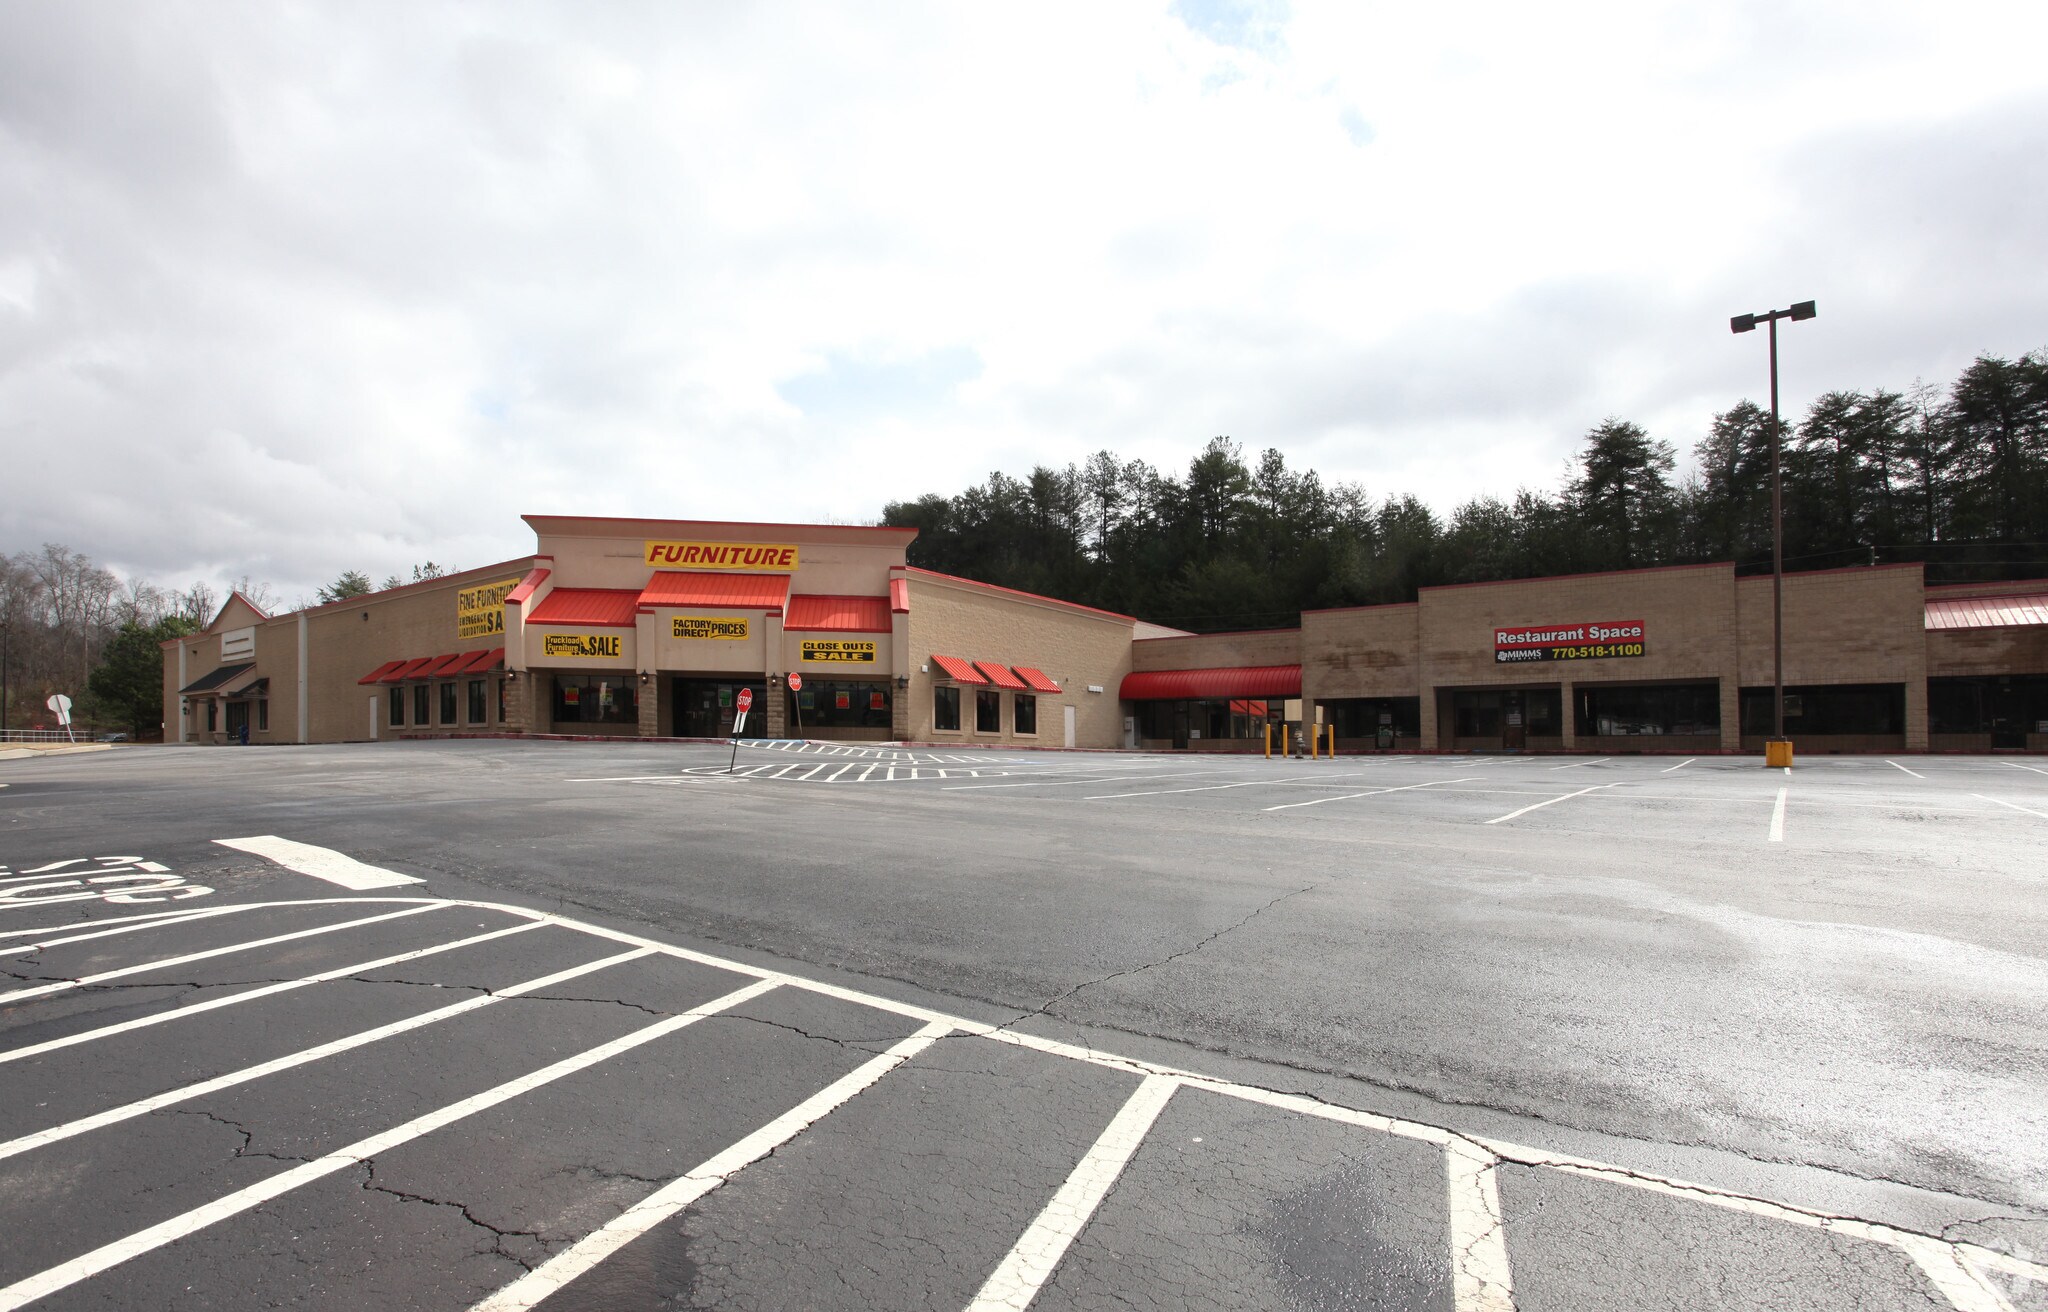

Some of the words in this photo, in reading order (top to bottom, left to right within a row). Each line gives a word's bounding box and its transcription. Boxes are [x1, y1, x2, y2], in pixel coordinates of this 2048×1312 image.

[649, 545, 795, 565] FURNITURE
[459, 592, 475, 611] FINE
[477, 583, 518, 608] FURNITU
[459, 613, 486, 626] EMERGENCY
[673, 619, 711, 629] FACTORY
[459, 624, 487, 637] LIQUIDATION
[673, 629, 709, 638] DIRECT
[711, 622, 745, 635] PRICES
[547, 636, 580, 644] Truckload
[1497, 628, 1584, 644] Restaurant
[1589, 626, 1642, 641] Space
[547, 644, 579, 652] Furniture
[589, 636, 619, 656] SALE
[803, 642, 839, 650] CLOSE
[1552, 644, 1642, 659] 770-518-1100
[813, 652, 864, 661] SALE
[1507, 650, 1542, 658] MIMMS
[738, 696, 751, 706] STOP
